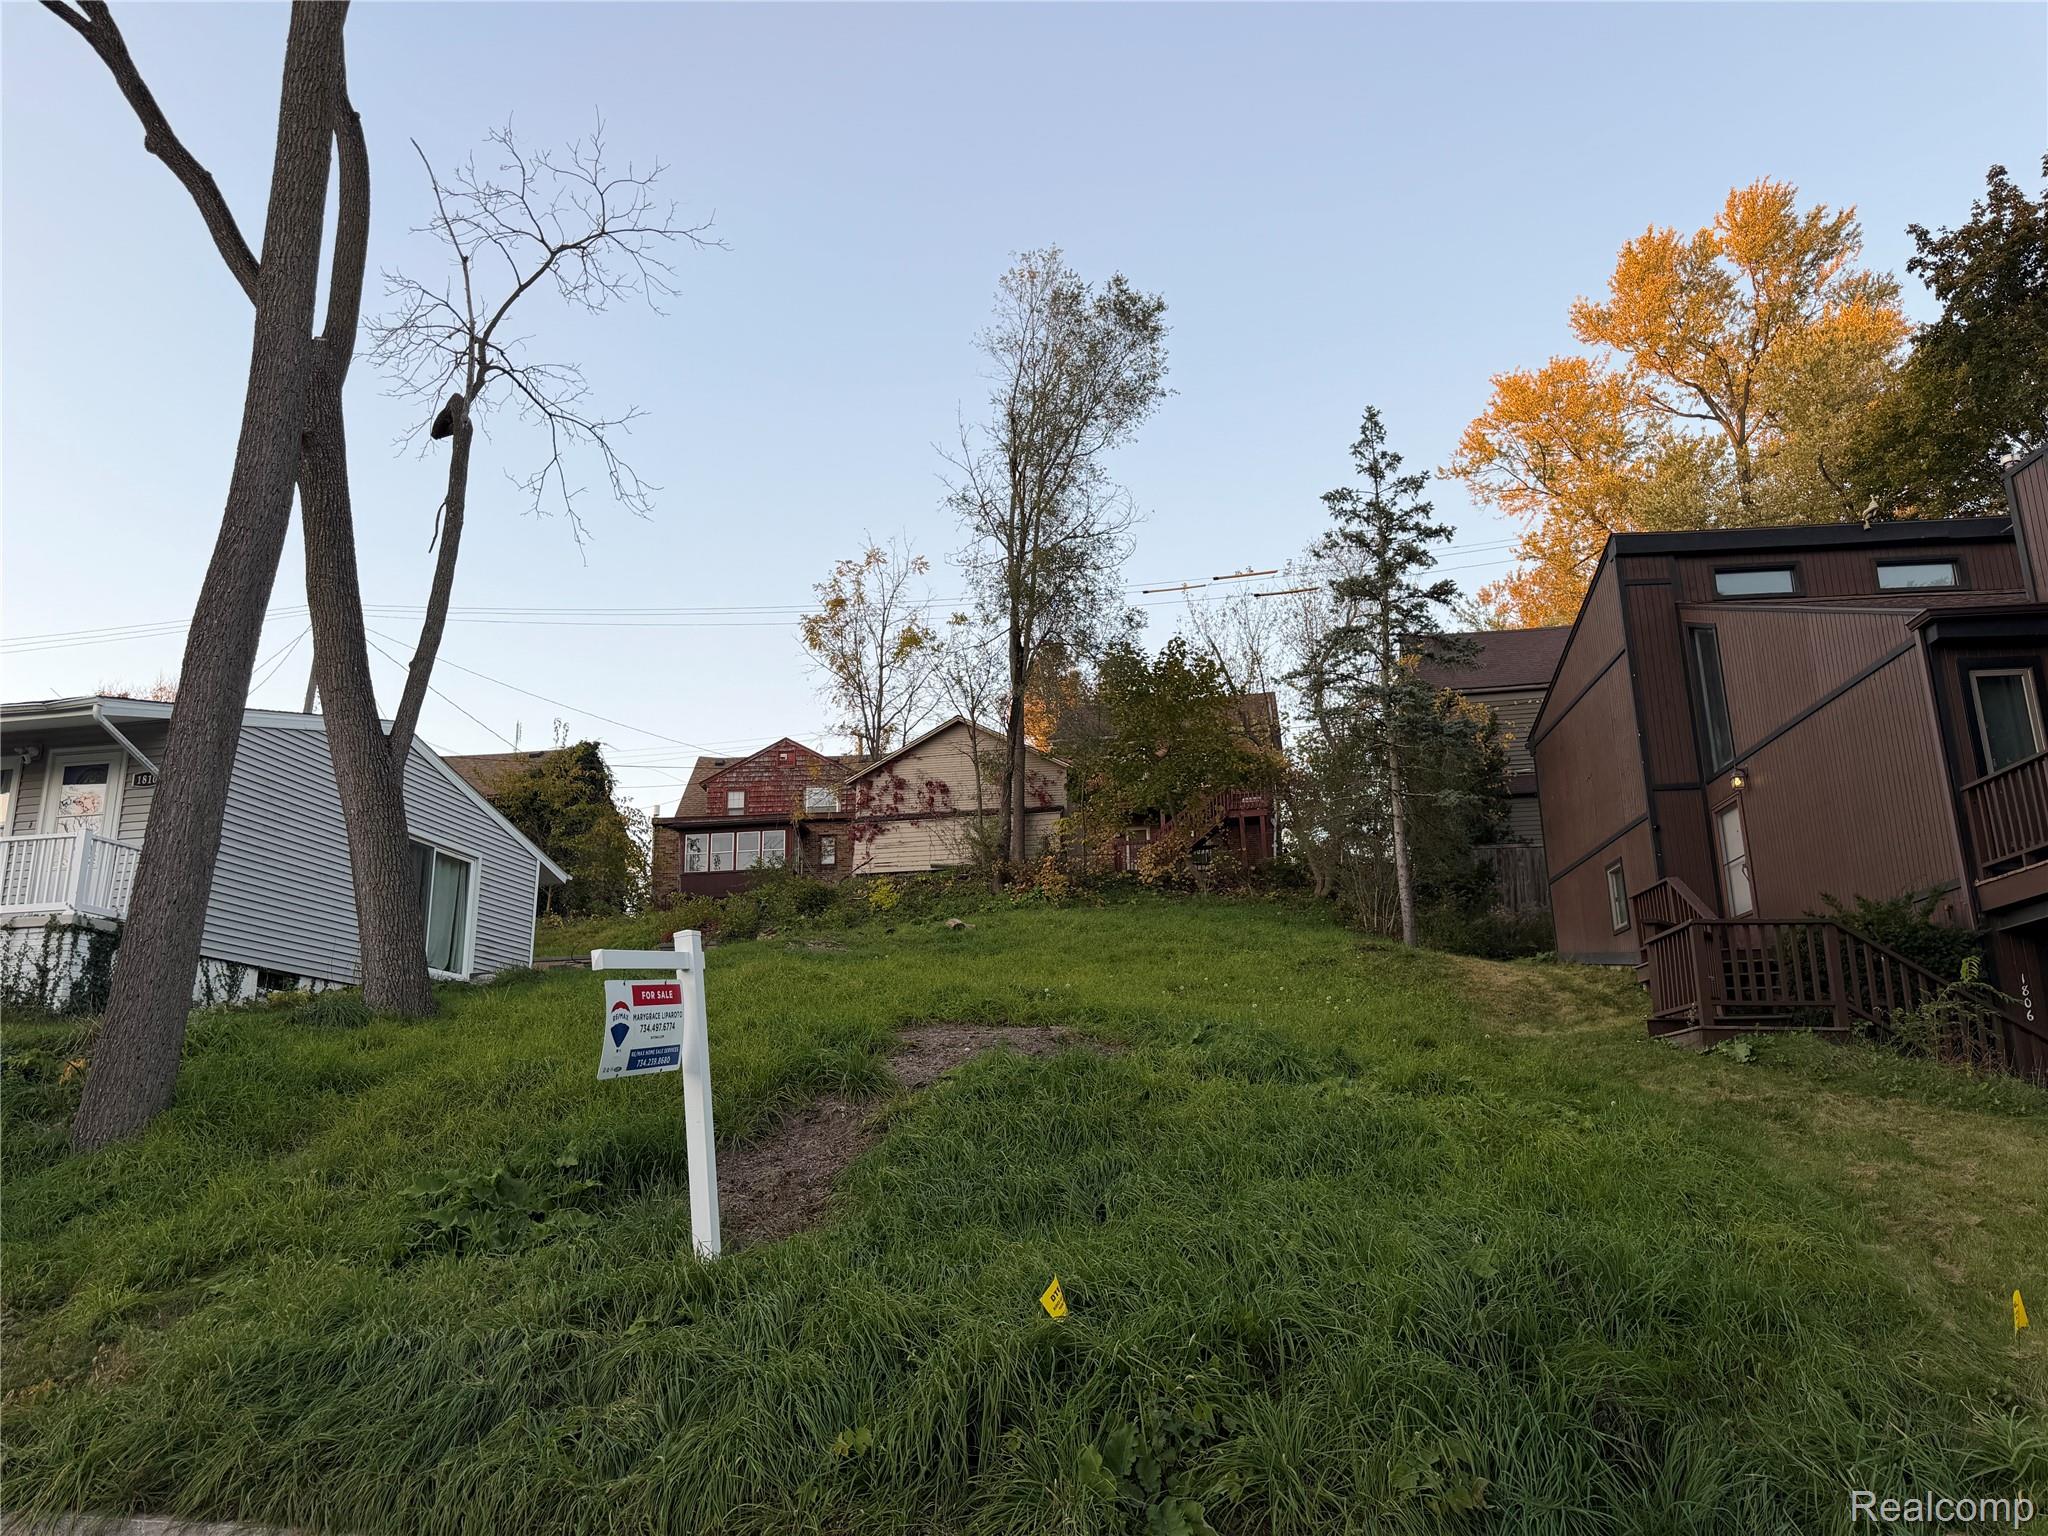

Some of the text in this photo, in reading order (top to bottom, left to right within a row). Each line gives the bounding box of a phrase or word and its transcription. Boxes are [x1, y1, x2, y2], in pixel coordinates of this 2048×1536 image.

[641, 990, 673, 999] FOR SALE
[2021, 973, 2034, 1021] 1806
